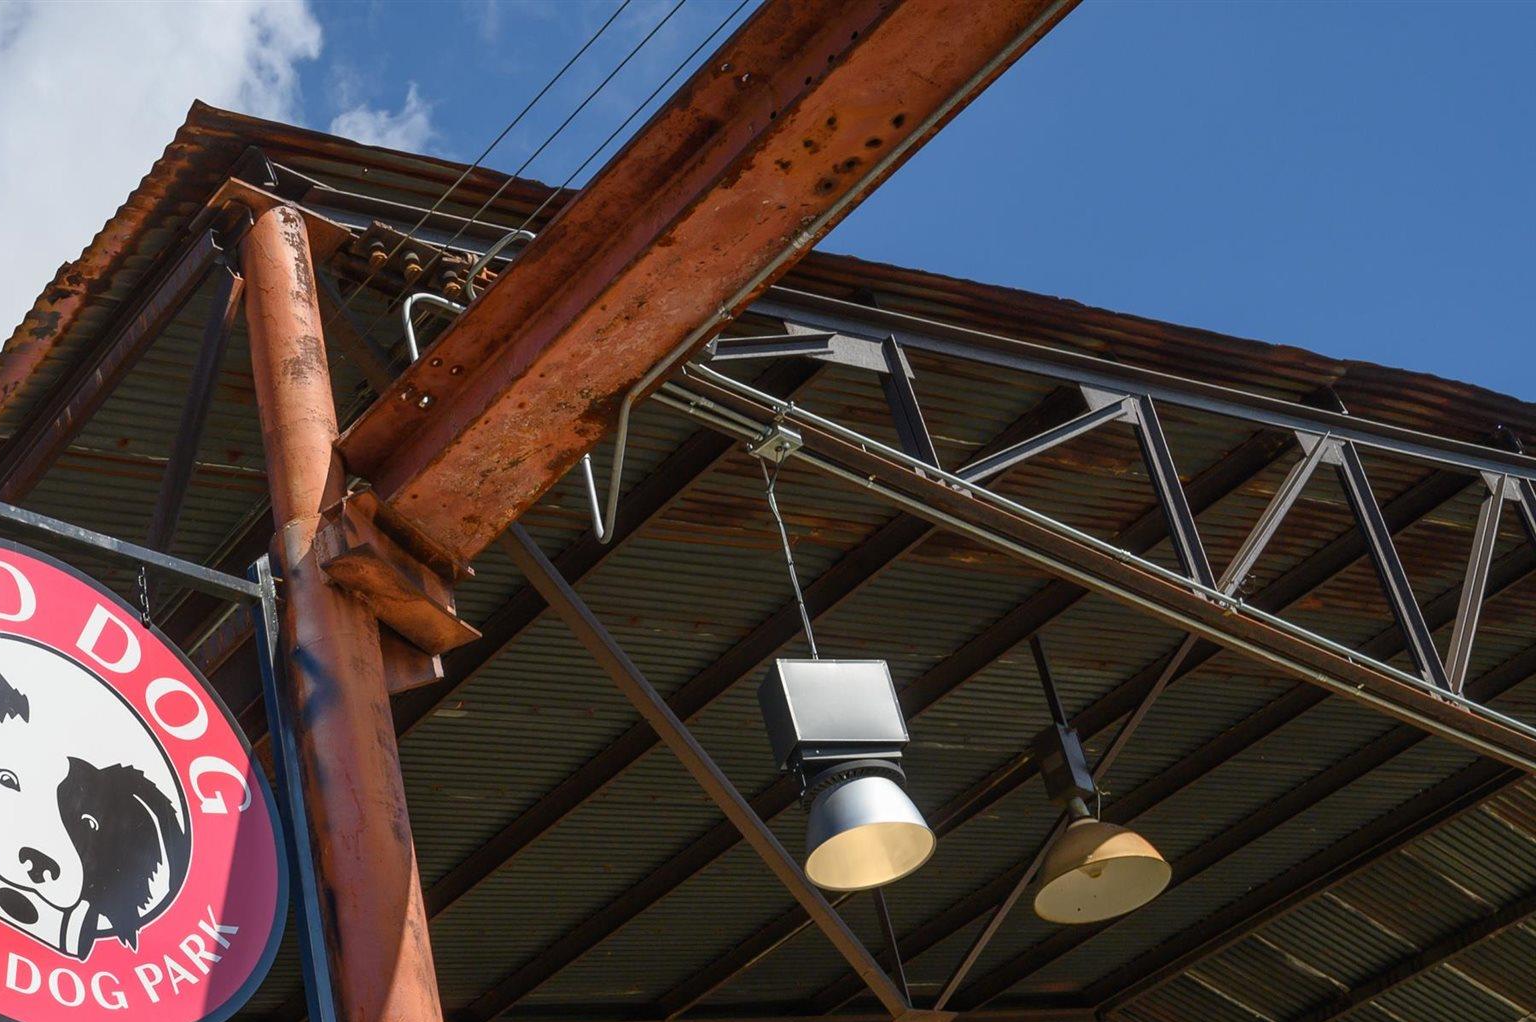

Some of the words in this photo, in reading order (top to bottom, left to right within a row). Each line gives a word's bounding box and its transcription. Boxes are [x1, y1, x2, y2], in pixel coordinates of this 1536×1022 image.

[76, 603, 252, 814] DOG
[5, 952, 129, 1010] DOG
[134, 905, 240, 1003] PARK
